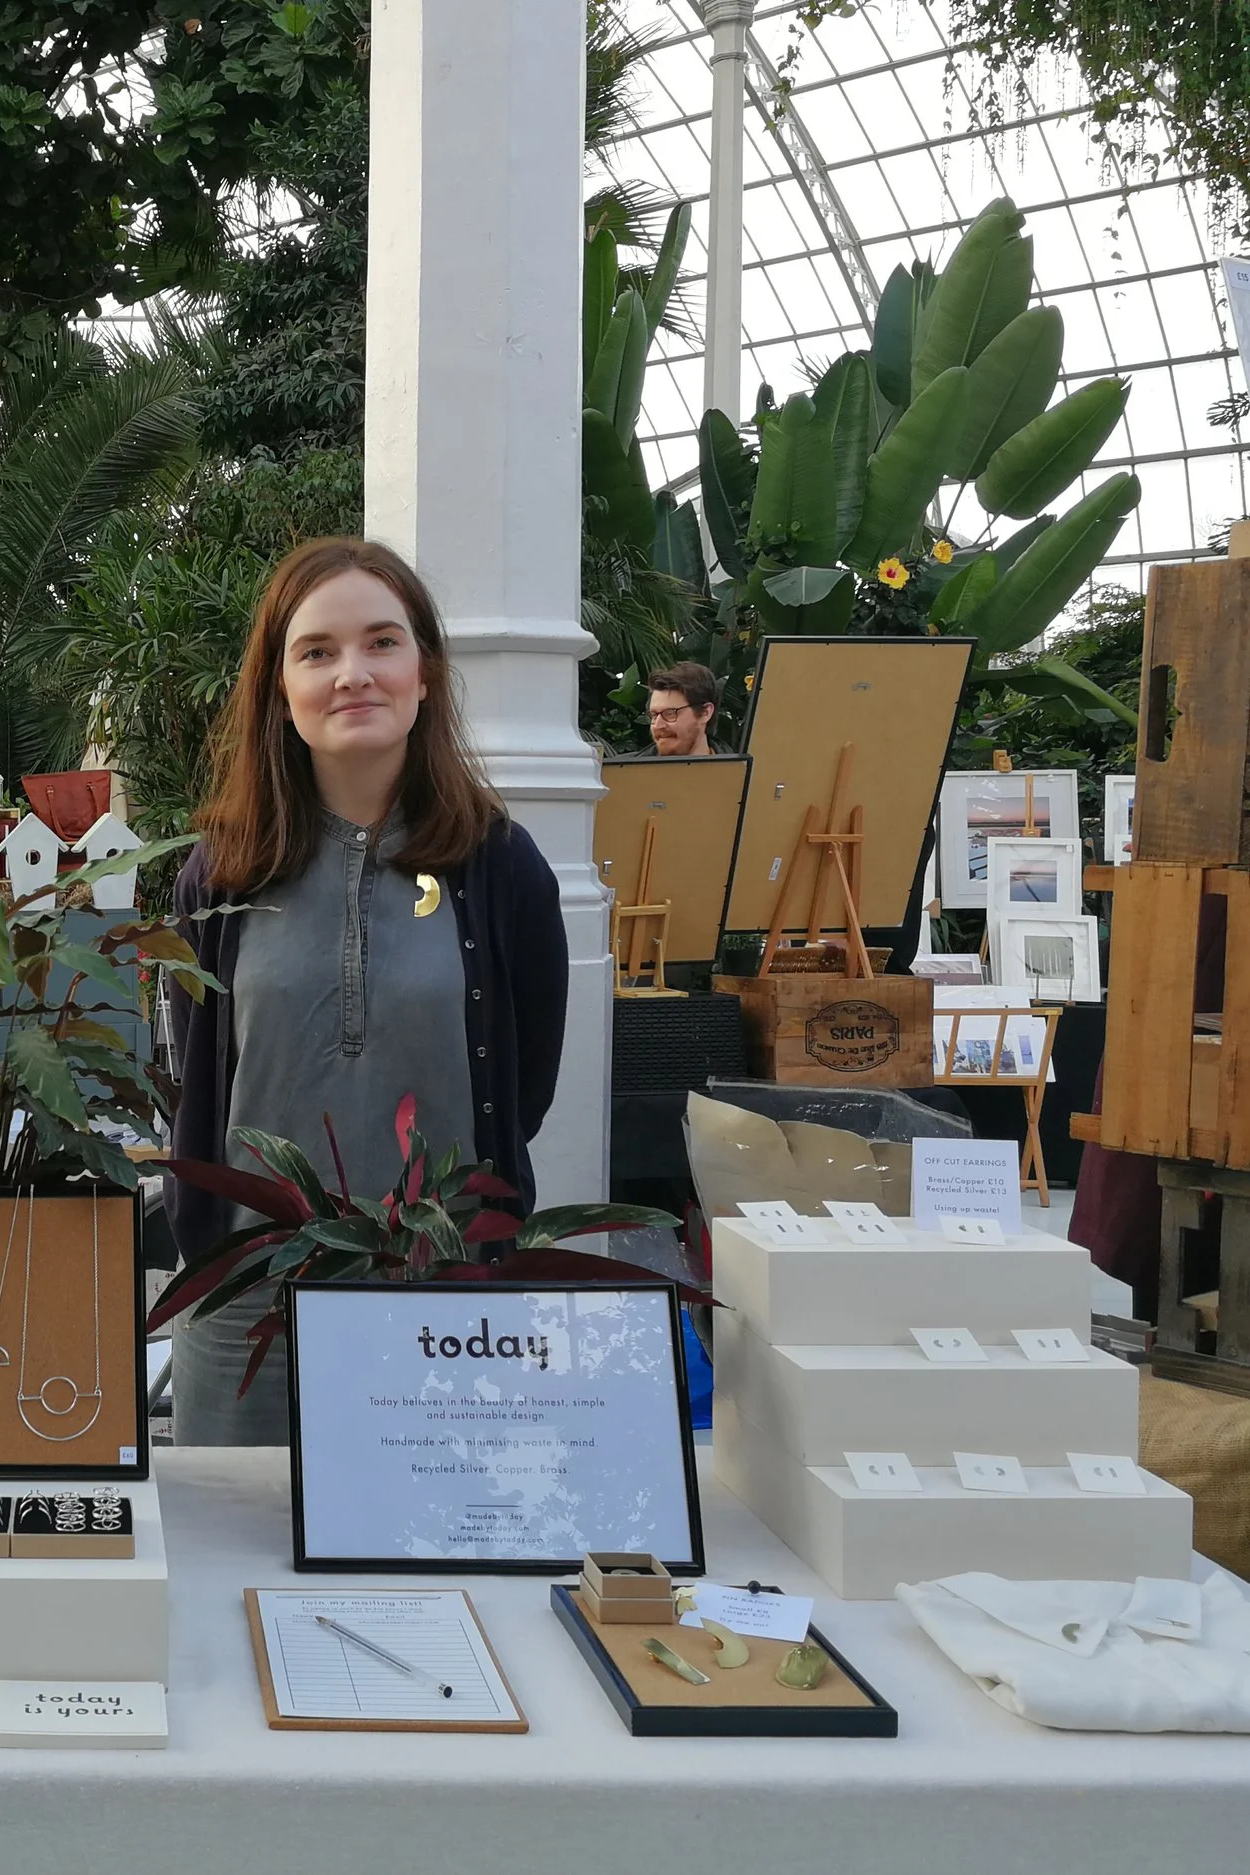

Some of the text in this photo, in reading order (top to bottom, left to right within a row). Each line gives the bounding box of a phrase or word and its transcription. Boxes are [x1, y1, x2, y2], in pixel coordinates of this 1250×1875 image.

[830, 1026, 874, 1040] PARIS
[924, 1157, 941, 1165] OFF
[963, 1159, 1007, 1167] EARRINGS
[928, 1176, 1004, 1186] Brass/Copper £10
[926, 1185, 1007, 1195] Recycled Silver £13
[934, 1204, 957, 1214] Using
[960, 1206, 971, 1214] up
[417, 1318, 548, 1371] today
[369, 1397, 398, 1407] Today
[402, 1397, 443, 1407] believes
[447, 1397, 457, 1406] in
[460, 1397, 476, 1406] the
[480, 1397, 514, 1408] beauty
[517, 1397, 528, 1406] of
[573, 1398, 605, 1409] simple
[426, 1411, 446, 1420] and
[450, 1411, 507, 1420] sustainable
[381, 1437, 435, 1447] Handmade
[438, 1437, 460, 1447] with
[464, 1438, 519, 1449] minimising
[523, 1439, 552, 1448] waste
[556, 1439, 566, 1447] in
[411, 1463, 456, 1475] Recycled
[496, 1464, 534, 1475] Copper.
[540, 1465, 571, 1475] Brass.
[36, 1693, 121, 1706] today
[25, 1704, 134, 1717] is yours
